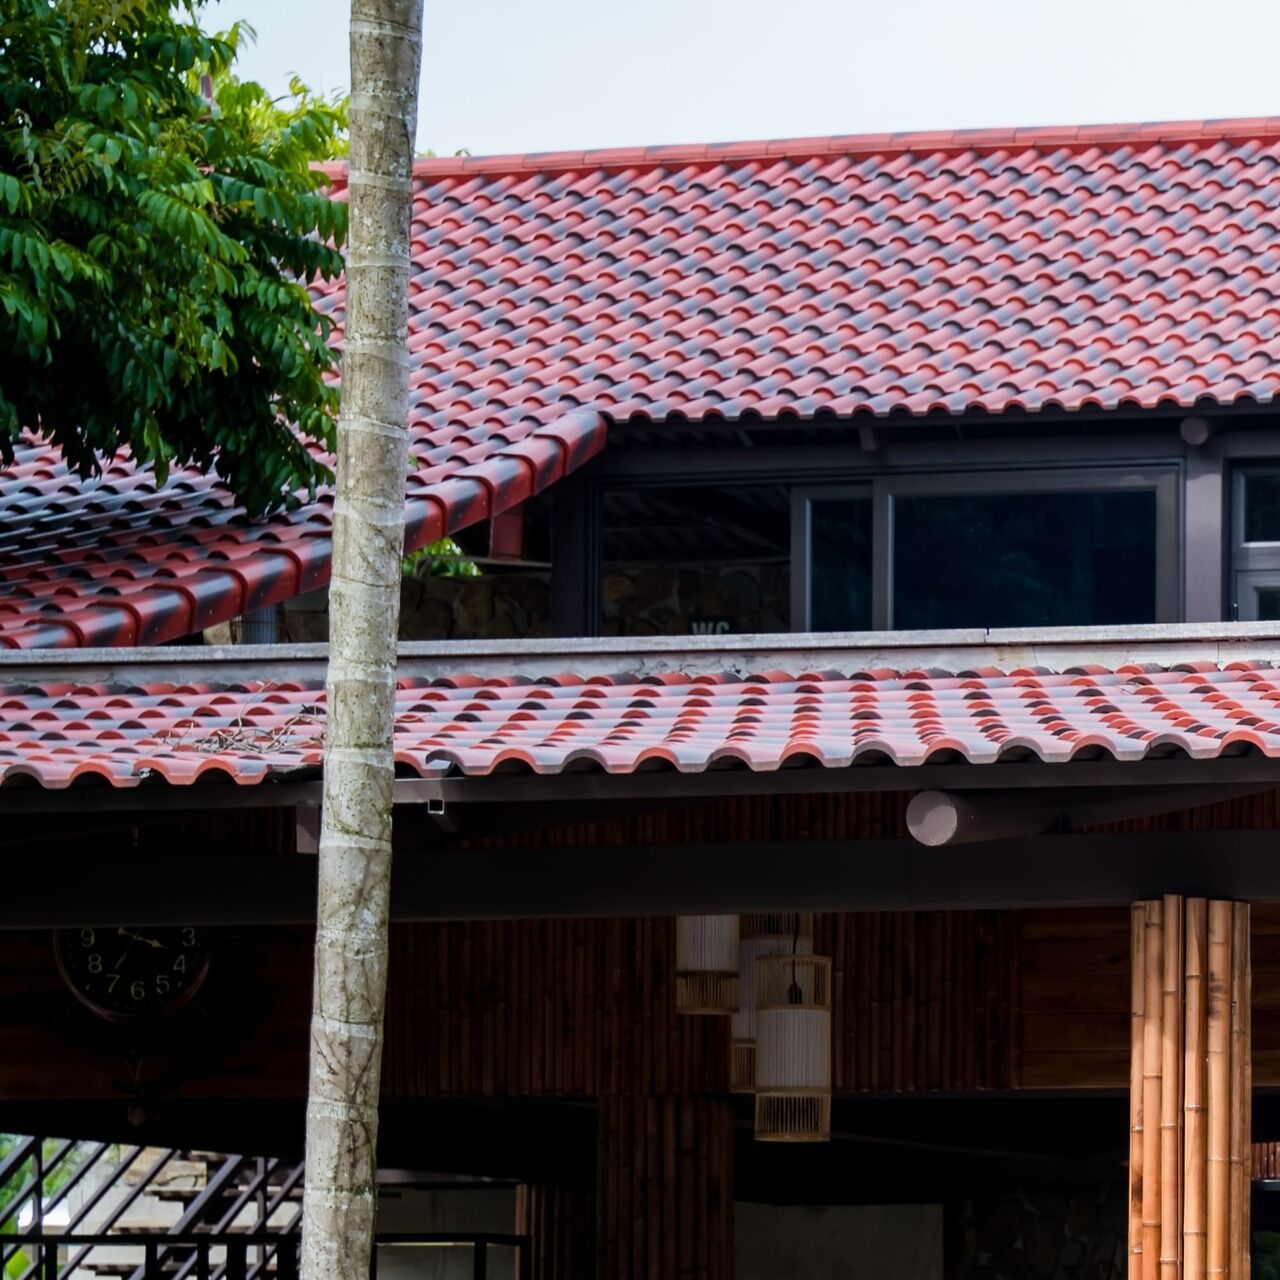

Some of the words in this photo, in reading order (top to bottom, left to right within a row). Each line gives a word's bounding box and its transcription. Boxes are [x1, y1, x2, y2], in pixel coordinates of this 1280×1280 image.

[81, 927, 95, 947] 9
[182, 927, 196, 946] 3
[88, 954, 102, 973] 8
[173, 954, 186, 973] 4
[106, 974, 120, 993] 7
[130, 981, 145, 1000] 6
[156, 975, 170, 994] 5
